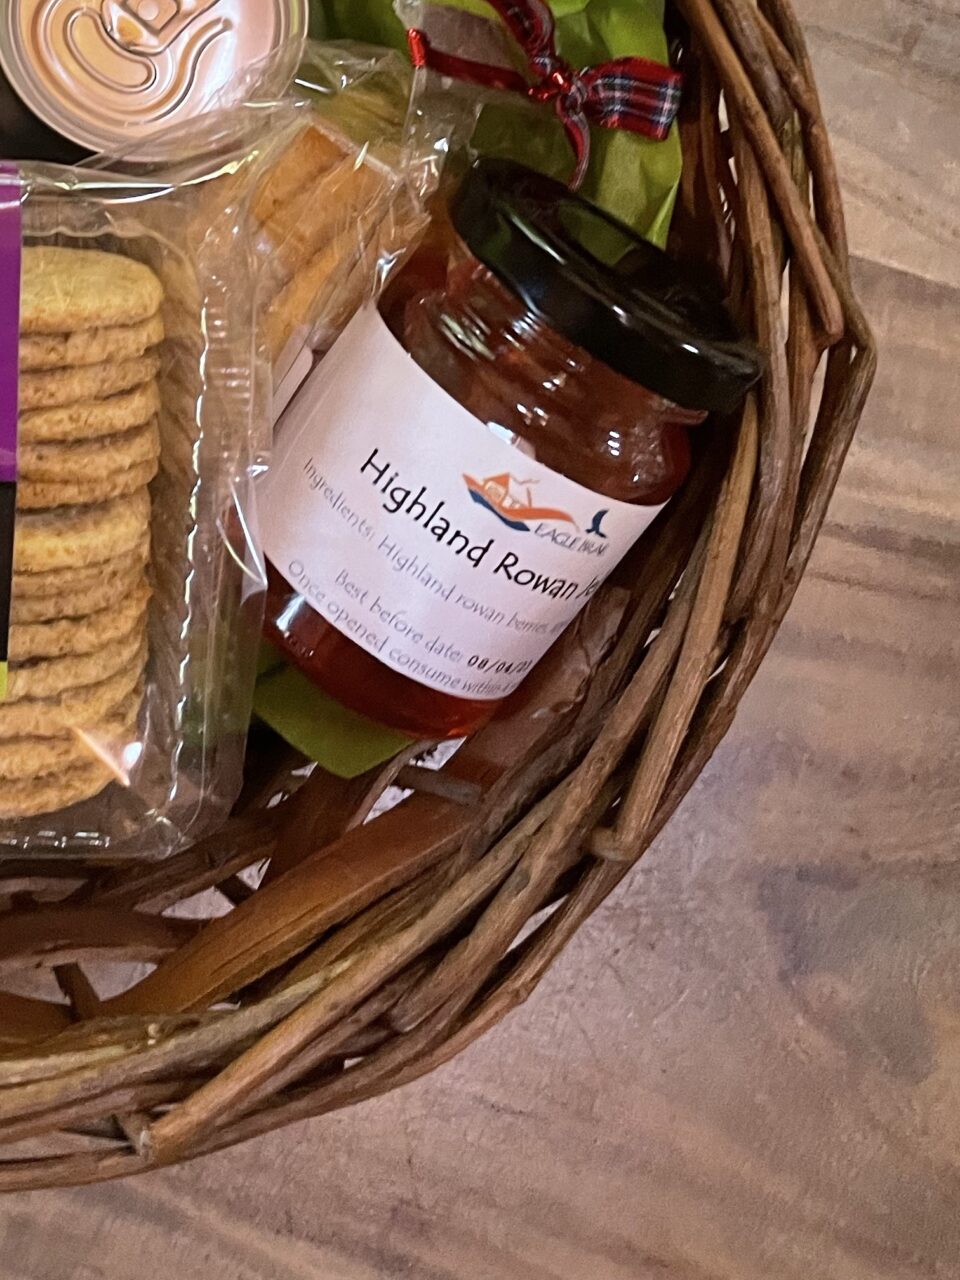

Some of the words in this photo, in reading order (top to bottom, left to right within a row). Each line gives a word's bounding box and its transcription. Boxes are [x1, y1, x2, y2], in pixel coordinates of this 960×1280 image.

[303, 456, 375, 541] Ingredients:
[377, 535, 456, 602] Highland
[455, 593, 505, 625] rowan
[360, 447, 495, 568] Highland
[493, 551, 579, 600] Rowan
[534, 522, 577, 551] EAGLE
[288, 559, 326, 602] Once
[327, 601, 390, 653] opened
[388, 647, 462, 689] consume
[334, 568, 369, 604] Best
[369, 595, 424, 643] before
